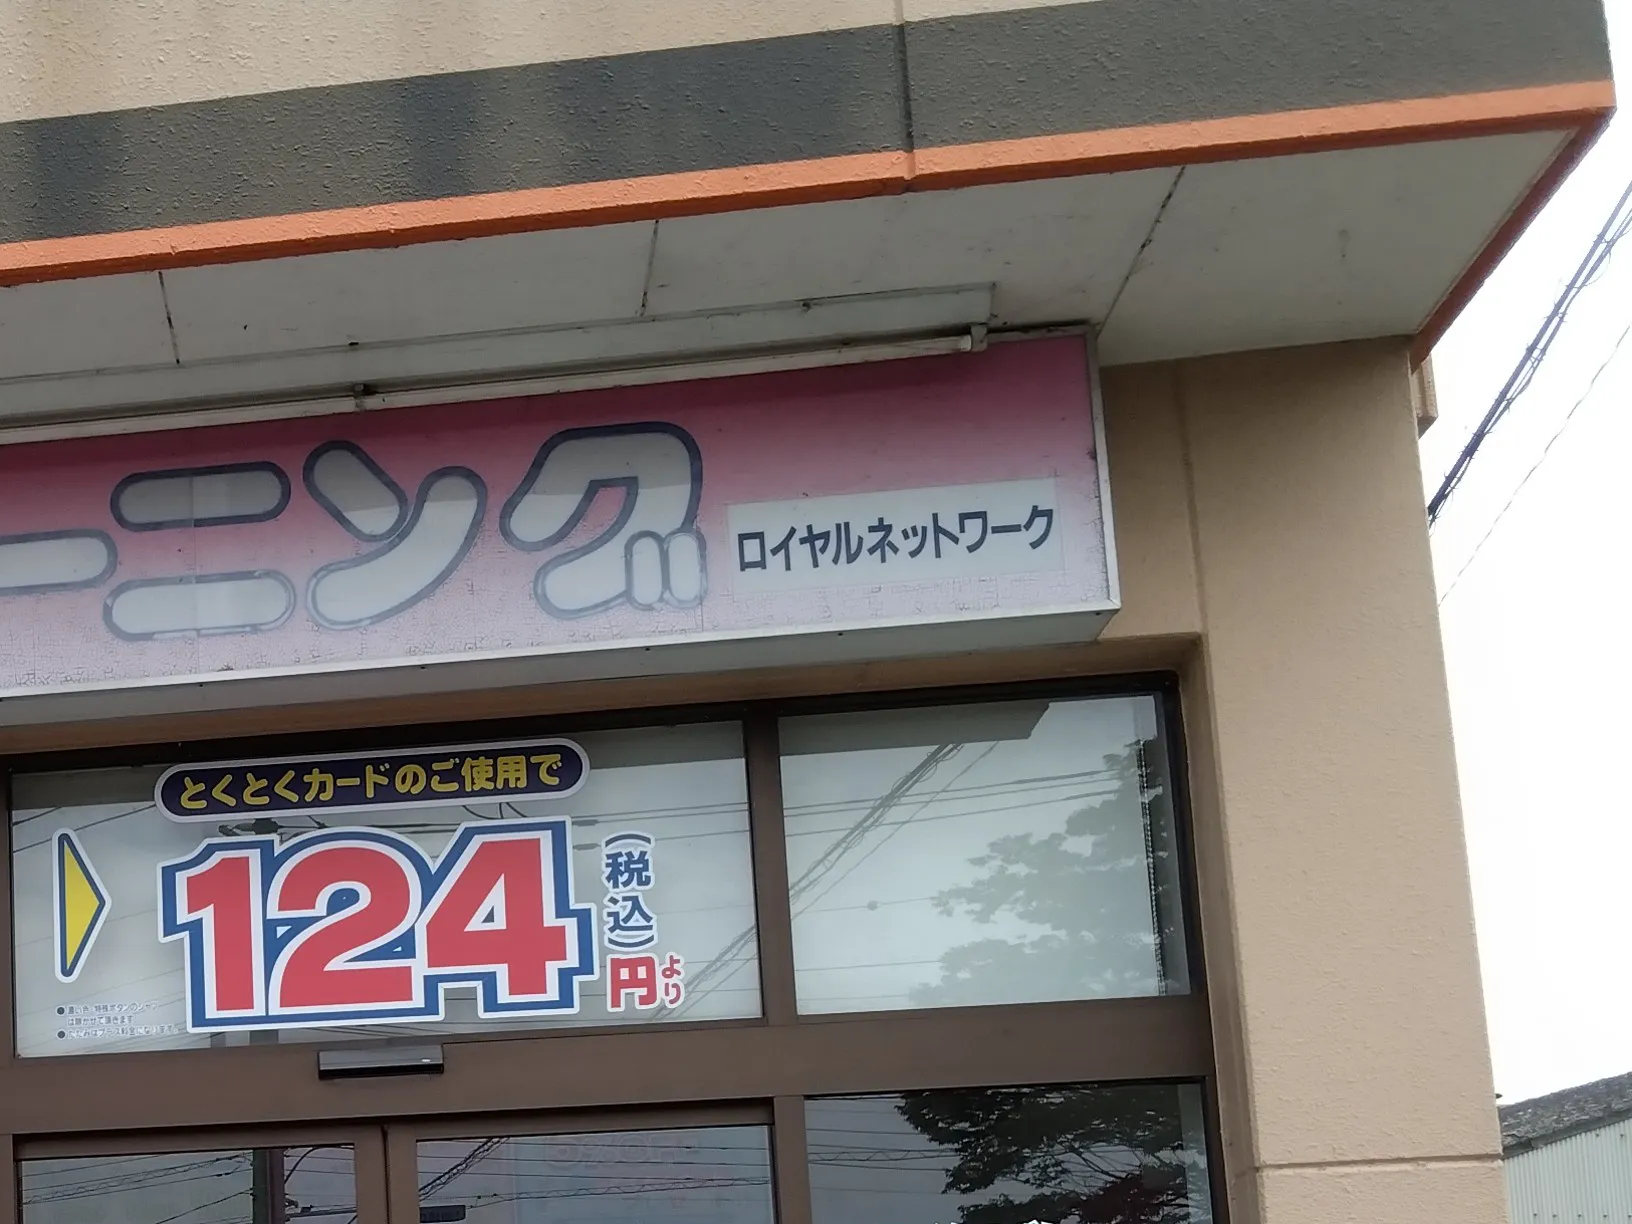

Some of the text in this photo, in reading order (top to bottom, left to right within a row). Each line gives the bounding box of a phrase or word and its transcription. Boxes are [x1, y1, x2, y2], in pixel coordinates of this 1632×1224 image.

[737, 503, 1055, 572] ロイヤルネットワーク
[179, 754, 565, 808] とくとくカードのご使用で
[171, 827, 585, 1022] 124
[610, 955, 658, 1010] 円
[660, 953, 685, 1006] より
